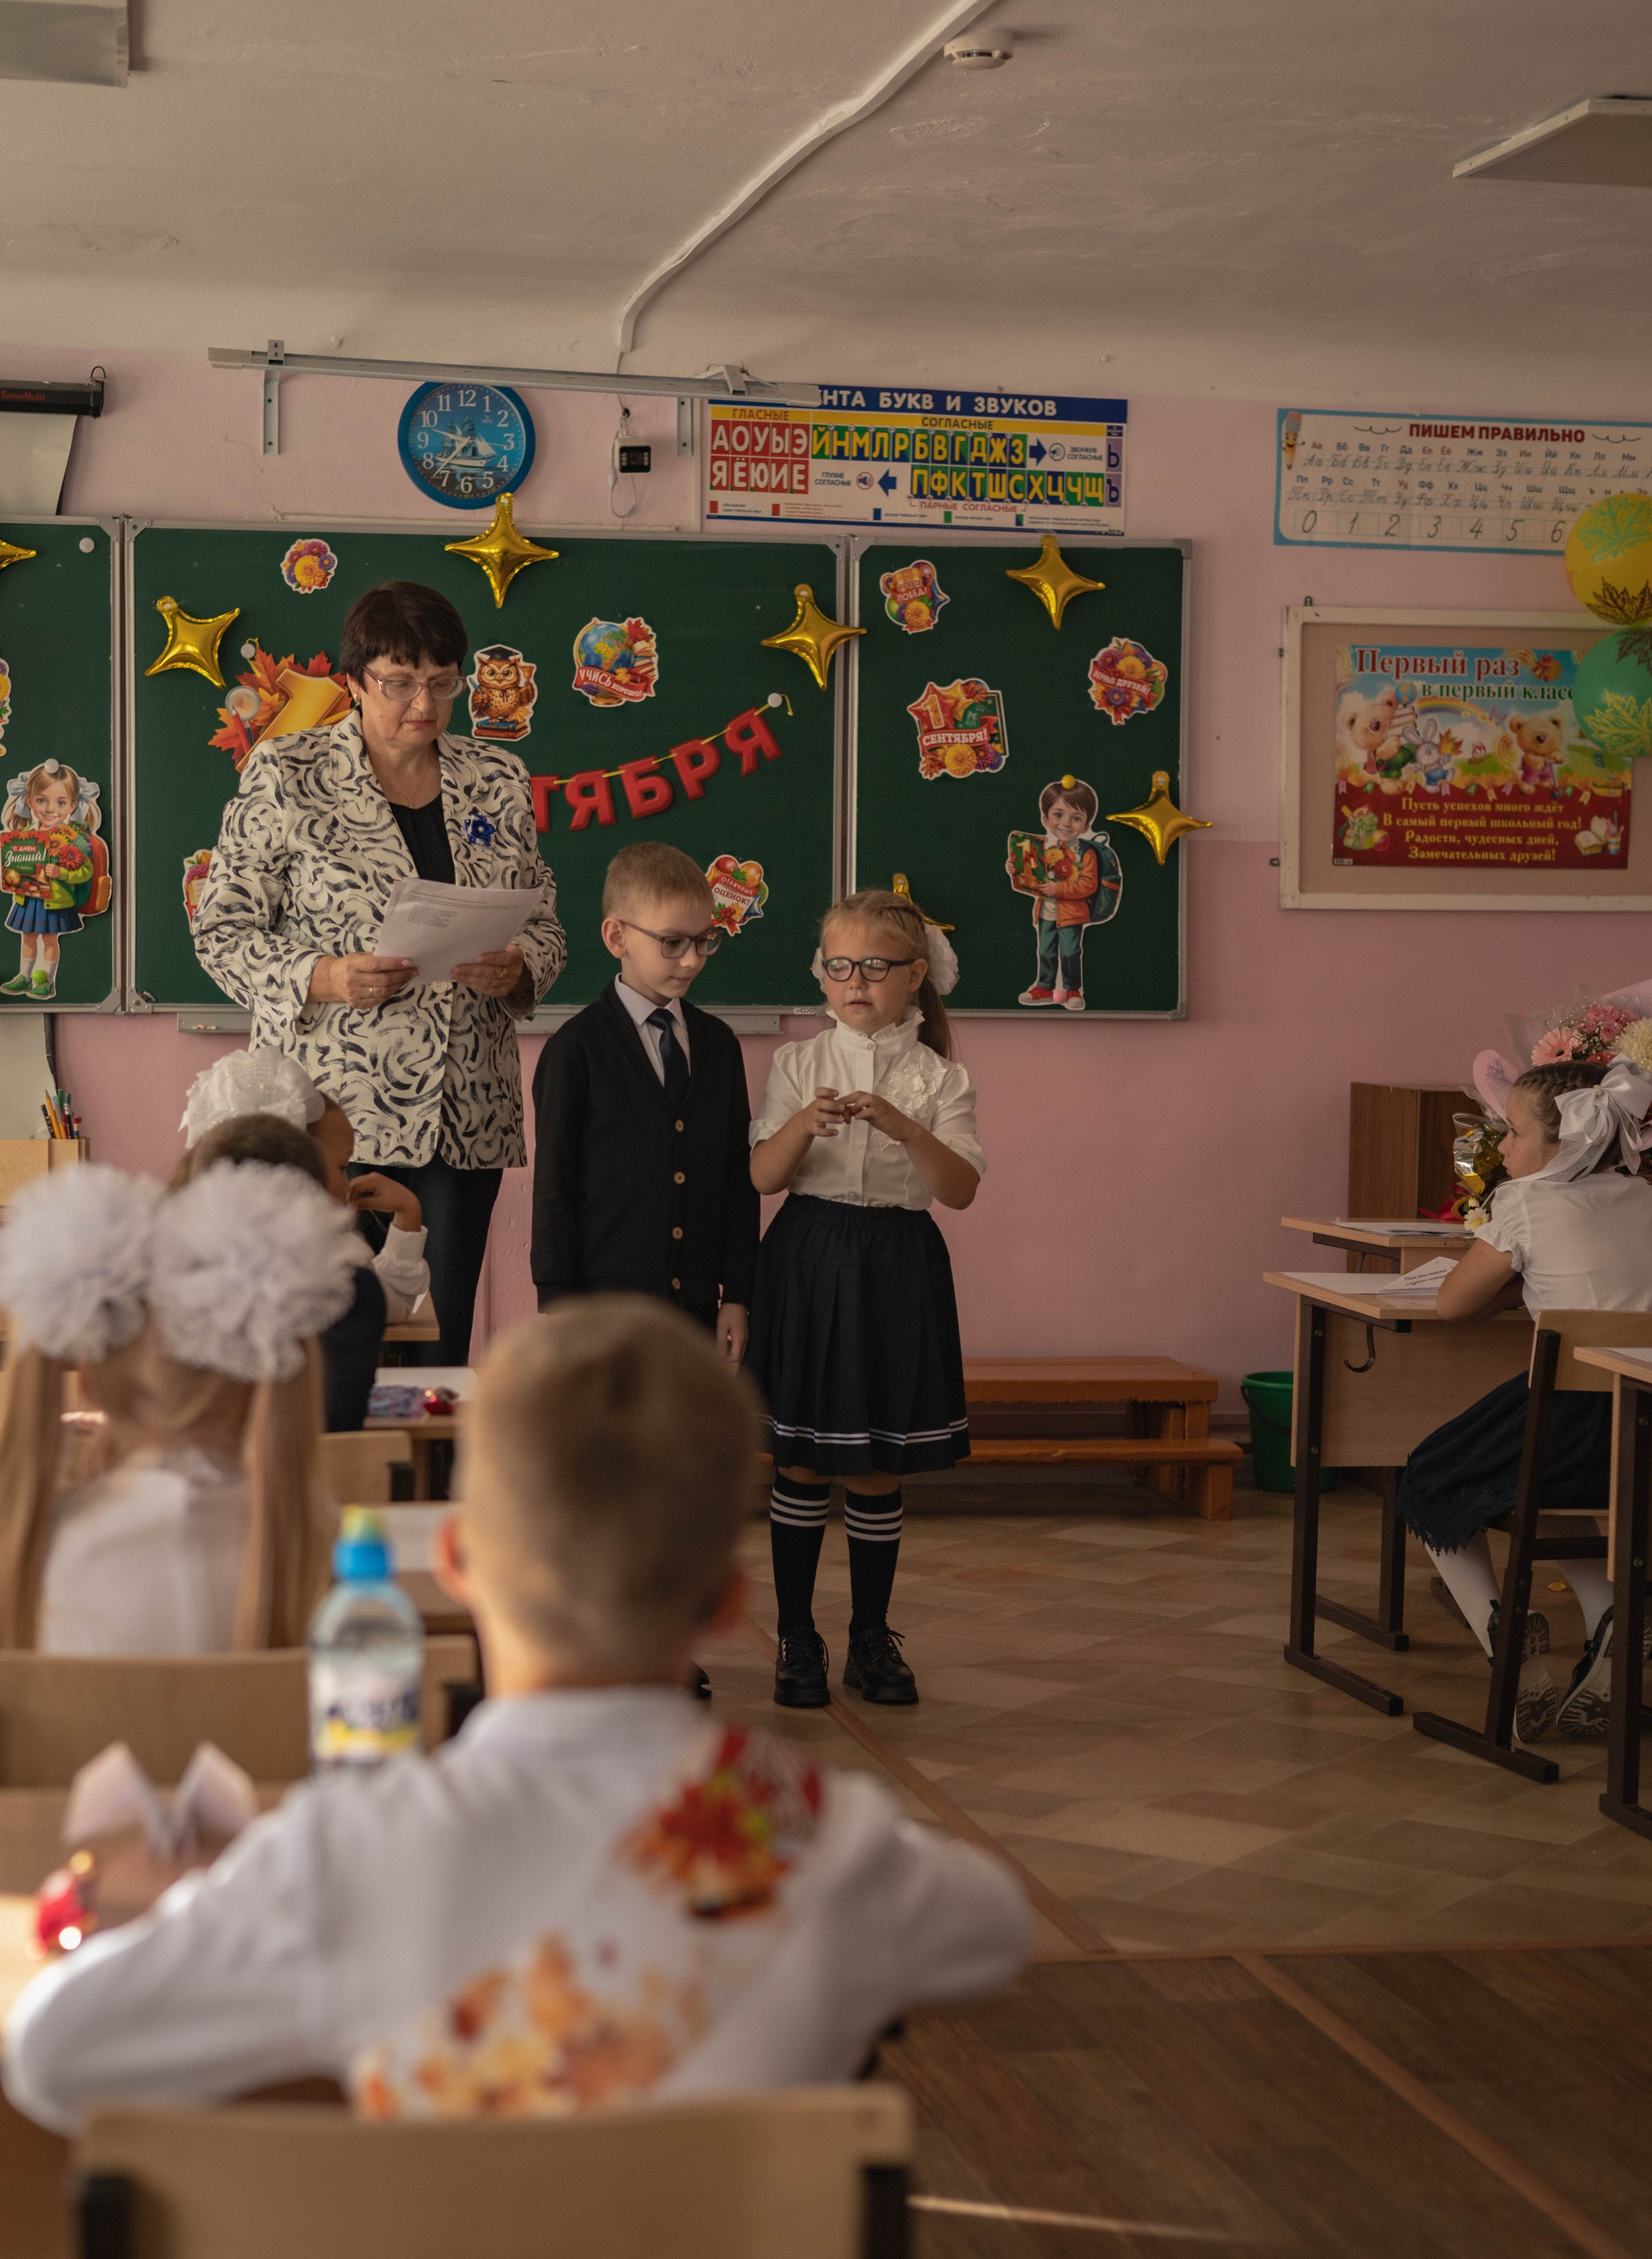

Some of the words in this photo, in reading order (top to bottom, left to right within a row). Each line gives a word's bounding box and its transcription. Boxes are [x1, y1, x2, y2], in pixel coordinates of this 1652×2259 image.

[437, 394, 452, 411] 11
[458, 389, 477, 407] 12
[483, 396, 491, 412] 1
[819, 389, 866, 407] НТА
[879, 391, 934, 410] БУКВ
[946, 395, 962, 412] И
[974, 396, 1058, 417] ЗВУКОВ
[419, 410, 438, 427] 10
[497, 410, 509, 427] 2
[732, 408, 790, 421] ГЛАСНЫЕ
[922, 416, 994, 430] СОГЛАСНЫЕ
[417, 432, 429, 449] 9
[1409, 423, 1475, 440] ПИШЕМ
[1479, 425, 1585, 443] ПРАВИЛЬНО
[503, 433, 514, 451] 3
[423, 452, 434, 469] 8
[496, 455, 509, 472] 4
[439, 470, 450, 487] 7
[461, 476, 473, 494] 6
[483, 471, 494, 489] 5
[814, 478, 852, 487] СОГЛАСНЫЕ
[920, 501, 958, 511] ПАРНЫЕ
[963, 503, 1018, 513] СОГЛАСНЫЕ
[1302, 511, 1317, 534] 0
[1348, 513, 1358, 535] 1
[1385, 514, 1400, 537] 2
[1427, 516, 1442, 538] 3
[1469, 517, 1483, 539] 4
[1506, 519, 1524, 541] 5
[1551, 520, 1566, 542] 6
[1356, 649, 1467, 681] Первый
[1476, 657, 1520, 682] раз
[579, 669, 611, 687] УЧИСЬ
[1422, 684, 1432, 697] в
[1439, 680, 1515, 702] первый
[922, 694, 945, 729] 1
[923, 728, 988, 746] СЕНТЯБРЯ!
[1402, 798, 1440, 813] Пусть
[1444, 802, 1492, 813] успехов
[1495, 803, 1531, 813] много
[1534, 802, 1564, 814] ждёт
[1383, 813, 1393, 827] В
[1396, 815, 1436, 827] самый
[1440, 816, 1486, 830] первый
[1490, 817, 1554, 829] школьный
[1558, 816, 1582, 830] год!
[1405, 830, 1461, 844] Радости,
[1464, 833, 1523, 846] чудесных
[1526, 834, 1560, 846] дней,
[4, 848, 46, 867] Знаний!
[1408, 846, 1506, 861] Замечательных
[1509, 849, 1556, 864] друзей!
[714, 887, 750, 906] ОЦЕНОК!
